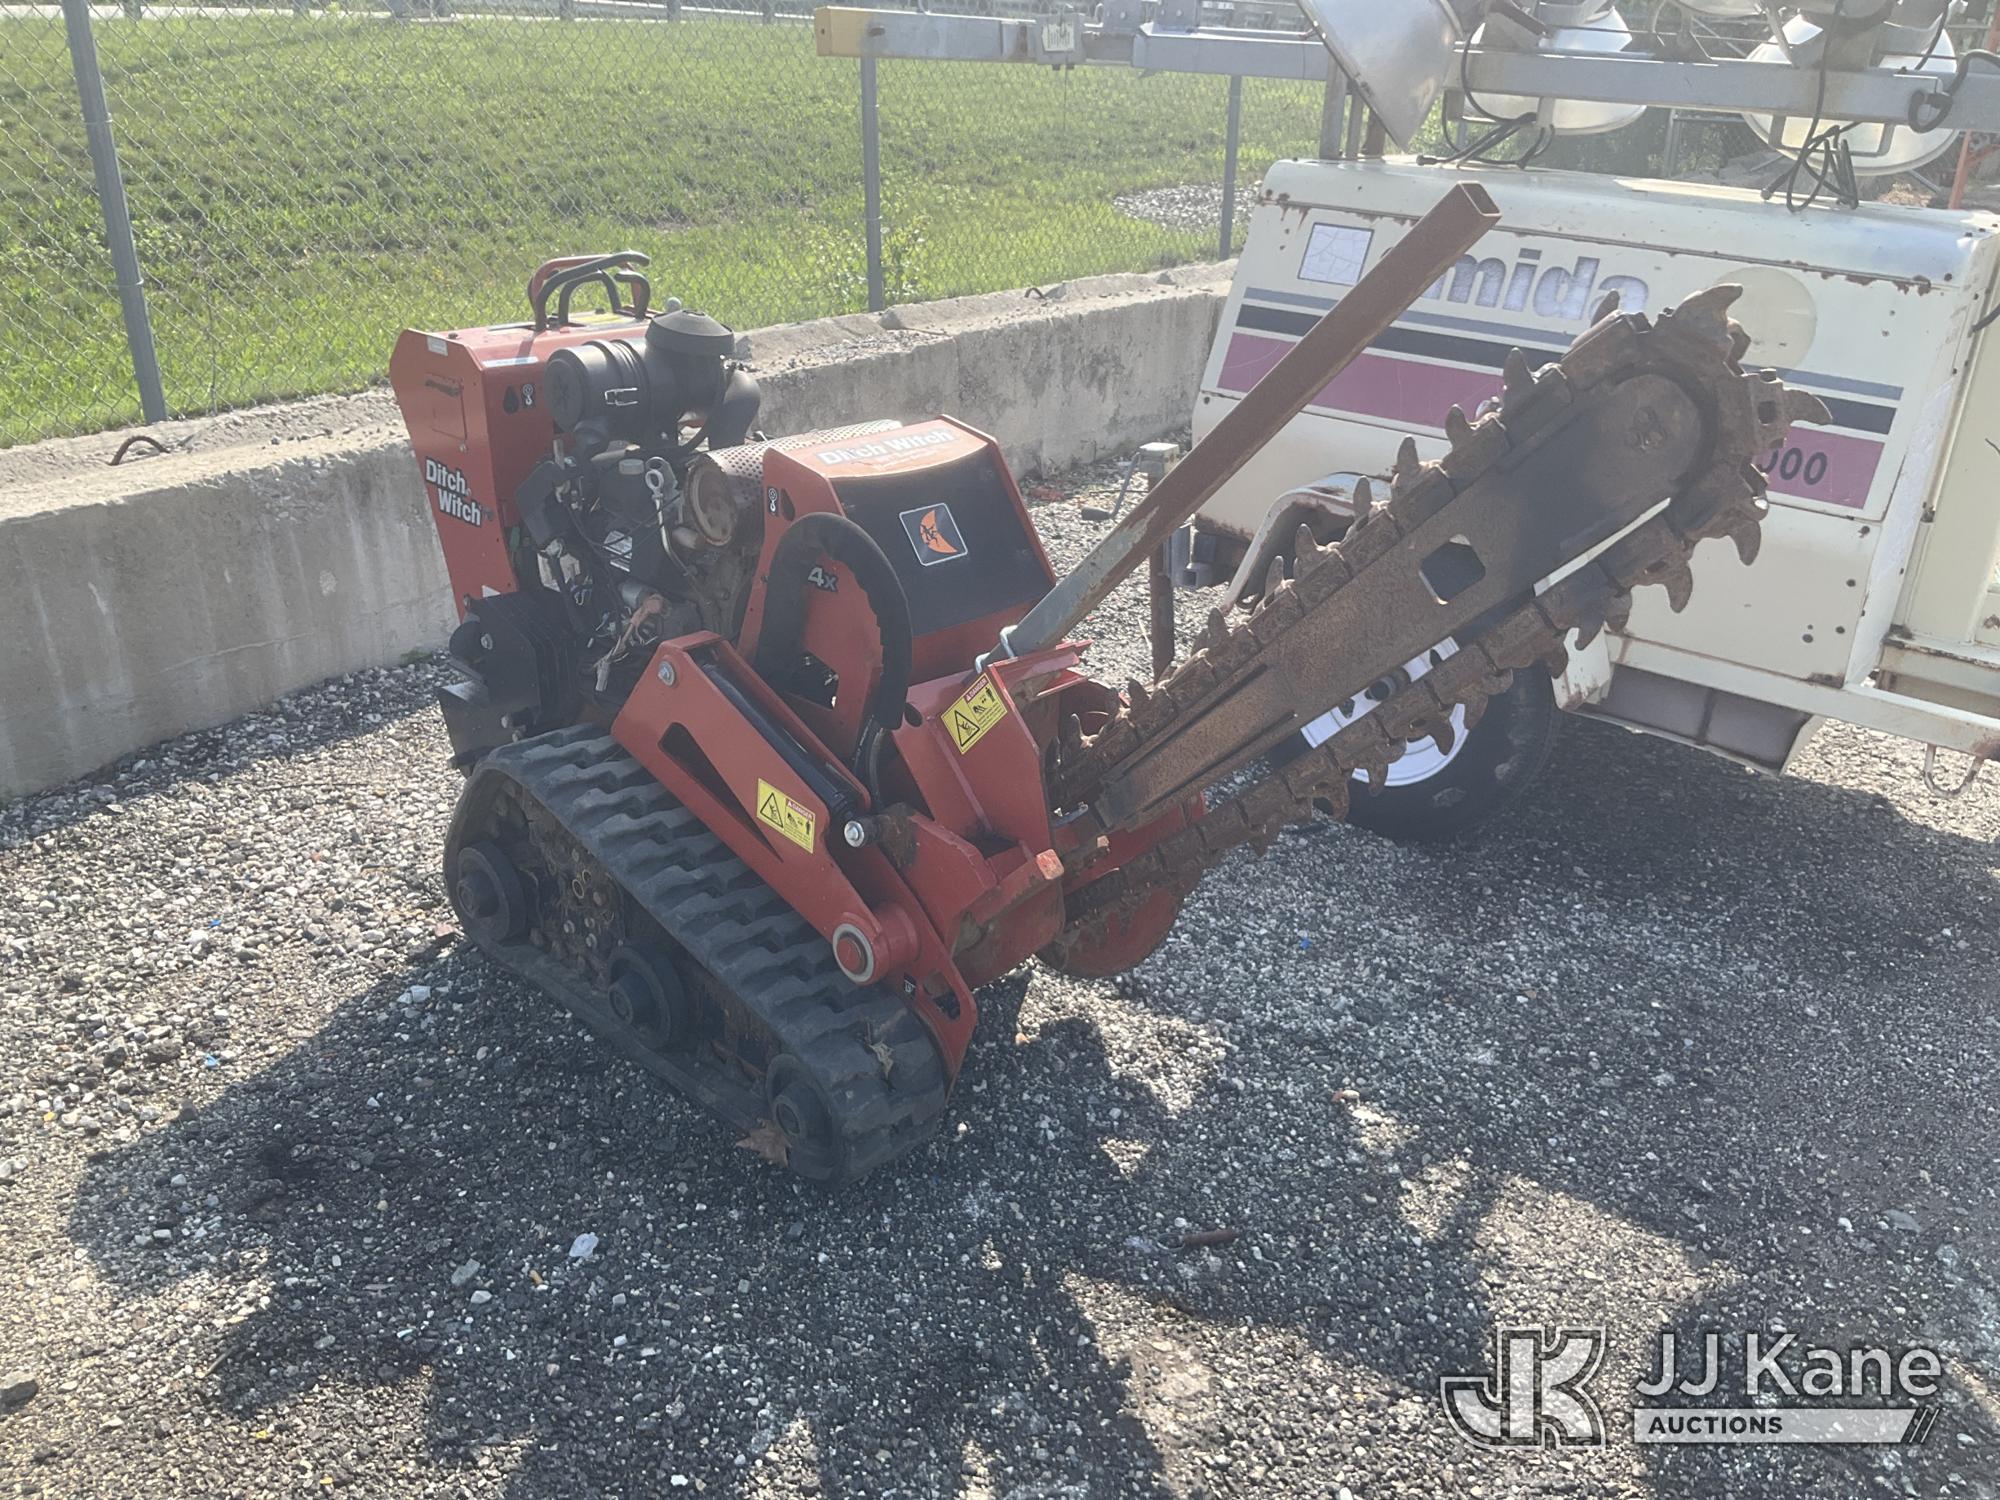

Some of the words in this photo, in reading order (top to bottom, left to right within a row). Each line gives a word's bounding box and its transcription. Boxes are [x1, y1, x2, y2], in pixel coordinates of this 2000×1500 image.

[1381, 247, 1649, 320] mida
[818, 443, 890, 465] Ditch
[884, 429, 956, 452] Witch
[426, 458, 466, 495] Ditch
[437, 487, 481, 526] Witch
